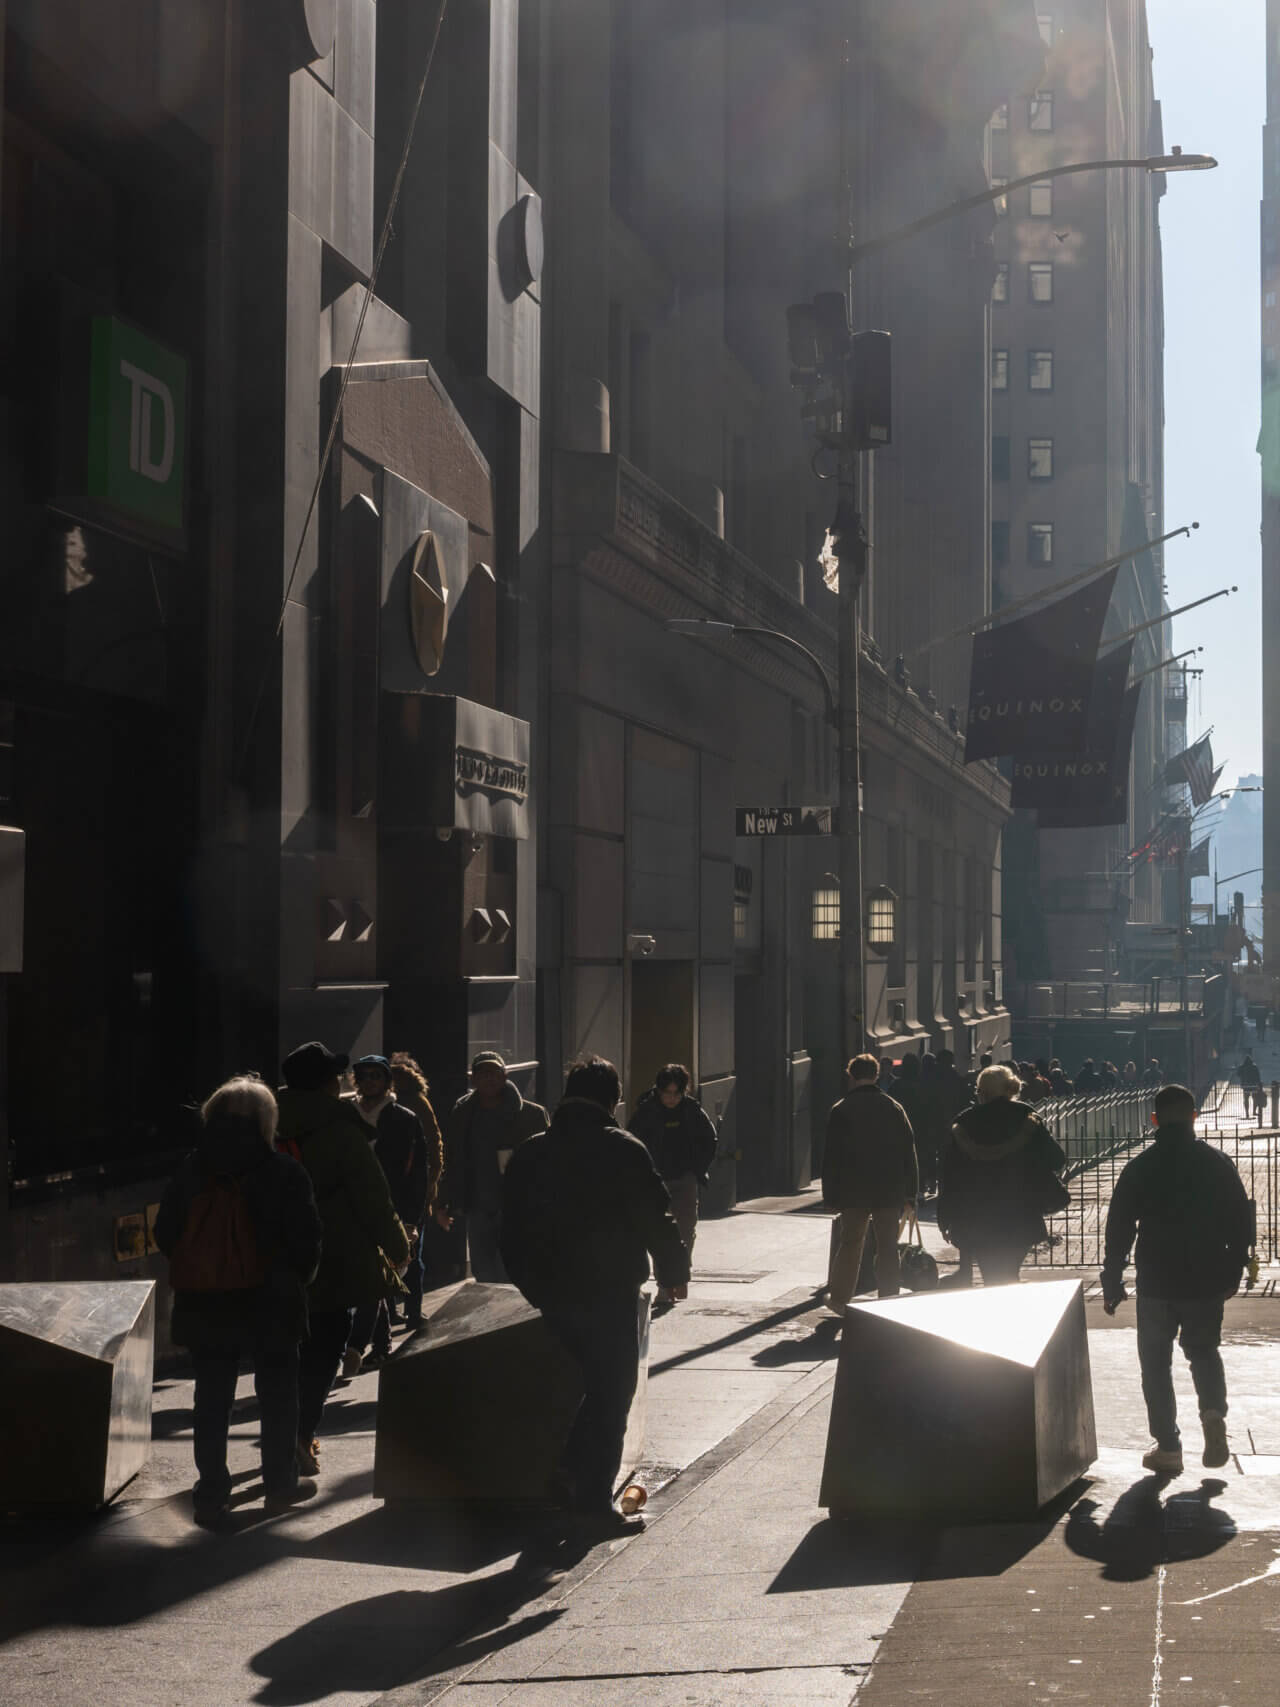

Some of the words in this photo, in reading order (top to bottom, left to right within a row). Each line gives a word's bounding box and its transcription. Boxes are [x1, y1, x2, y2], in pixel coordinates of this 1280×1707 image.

[120, 359, 174, 483] TD
[744, 813, 777, 834] New
[783, 812, 792, 826] St
